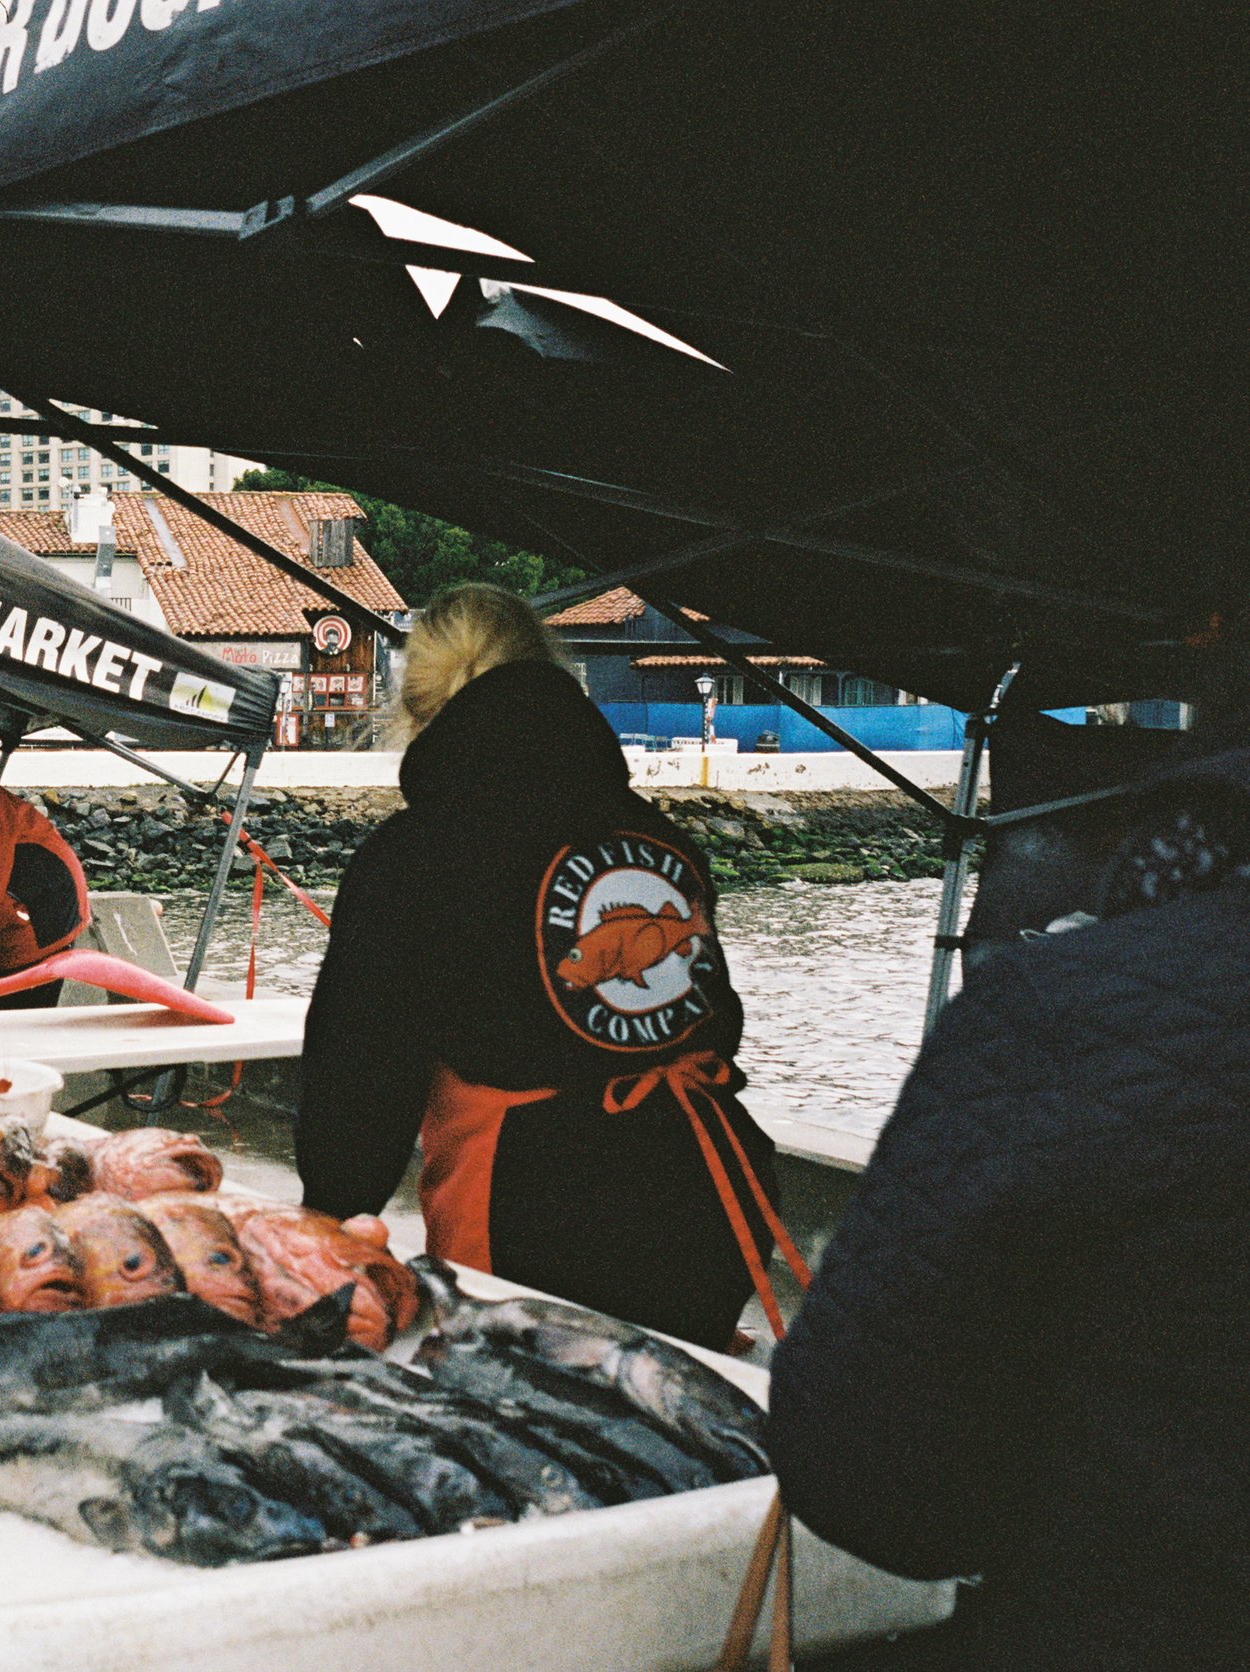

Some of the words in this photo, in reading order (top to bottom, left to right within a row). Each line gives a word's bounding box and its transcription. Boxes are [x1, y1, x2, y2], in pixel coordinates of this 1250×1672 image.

[262, 649, 299, 664] Pizza
[548, 854, 596, 930] RED
[598, 840, 683, 884] FISH
